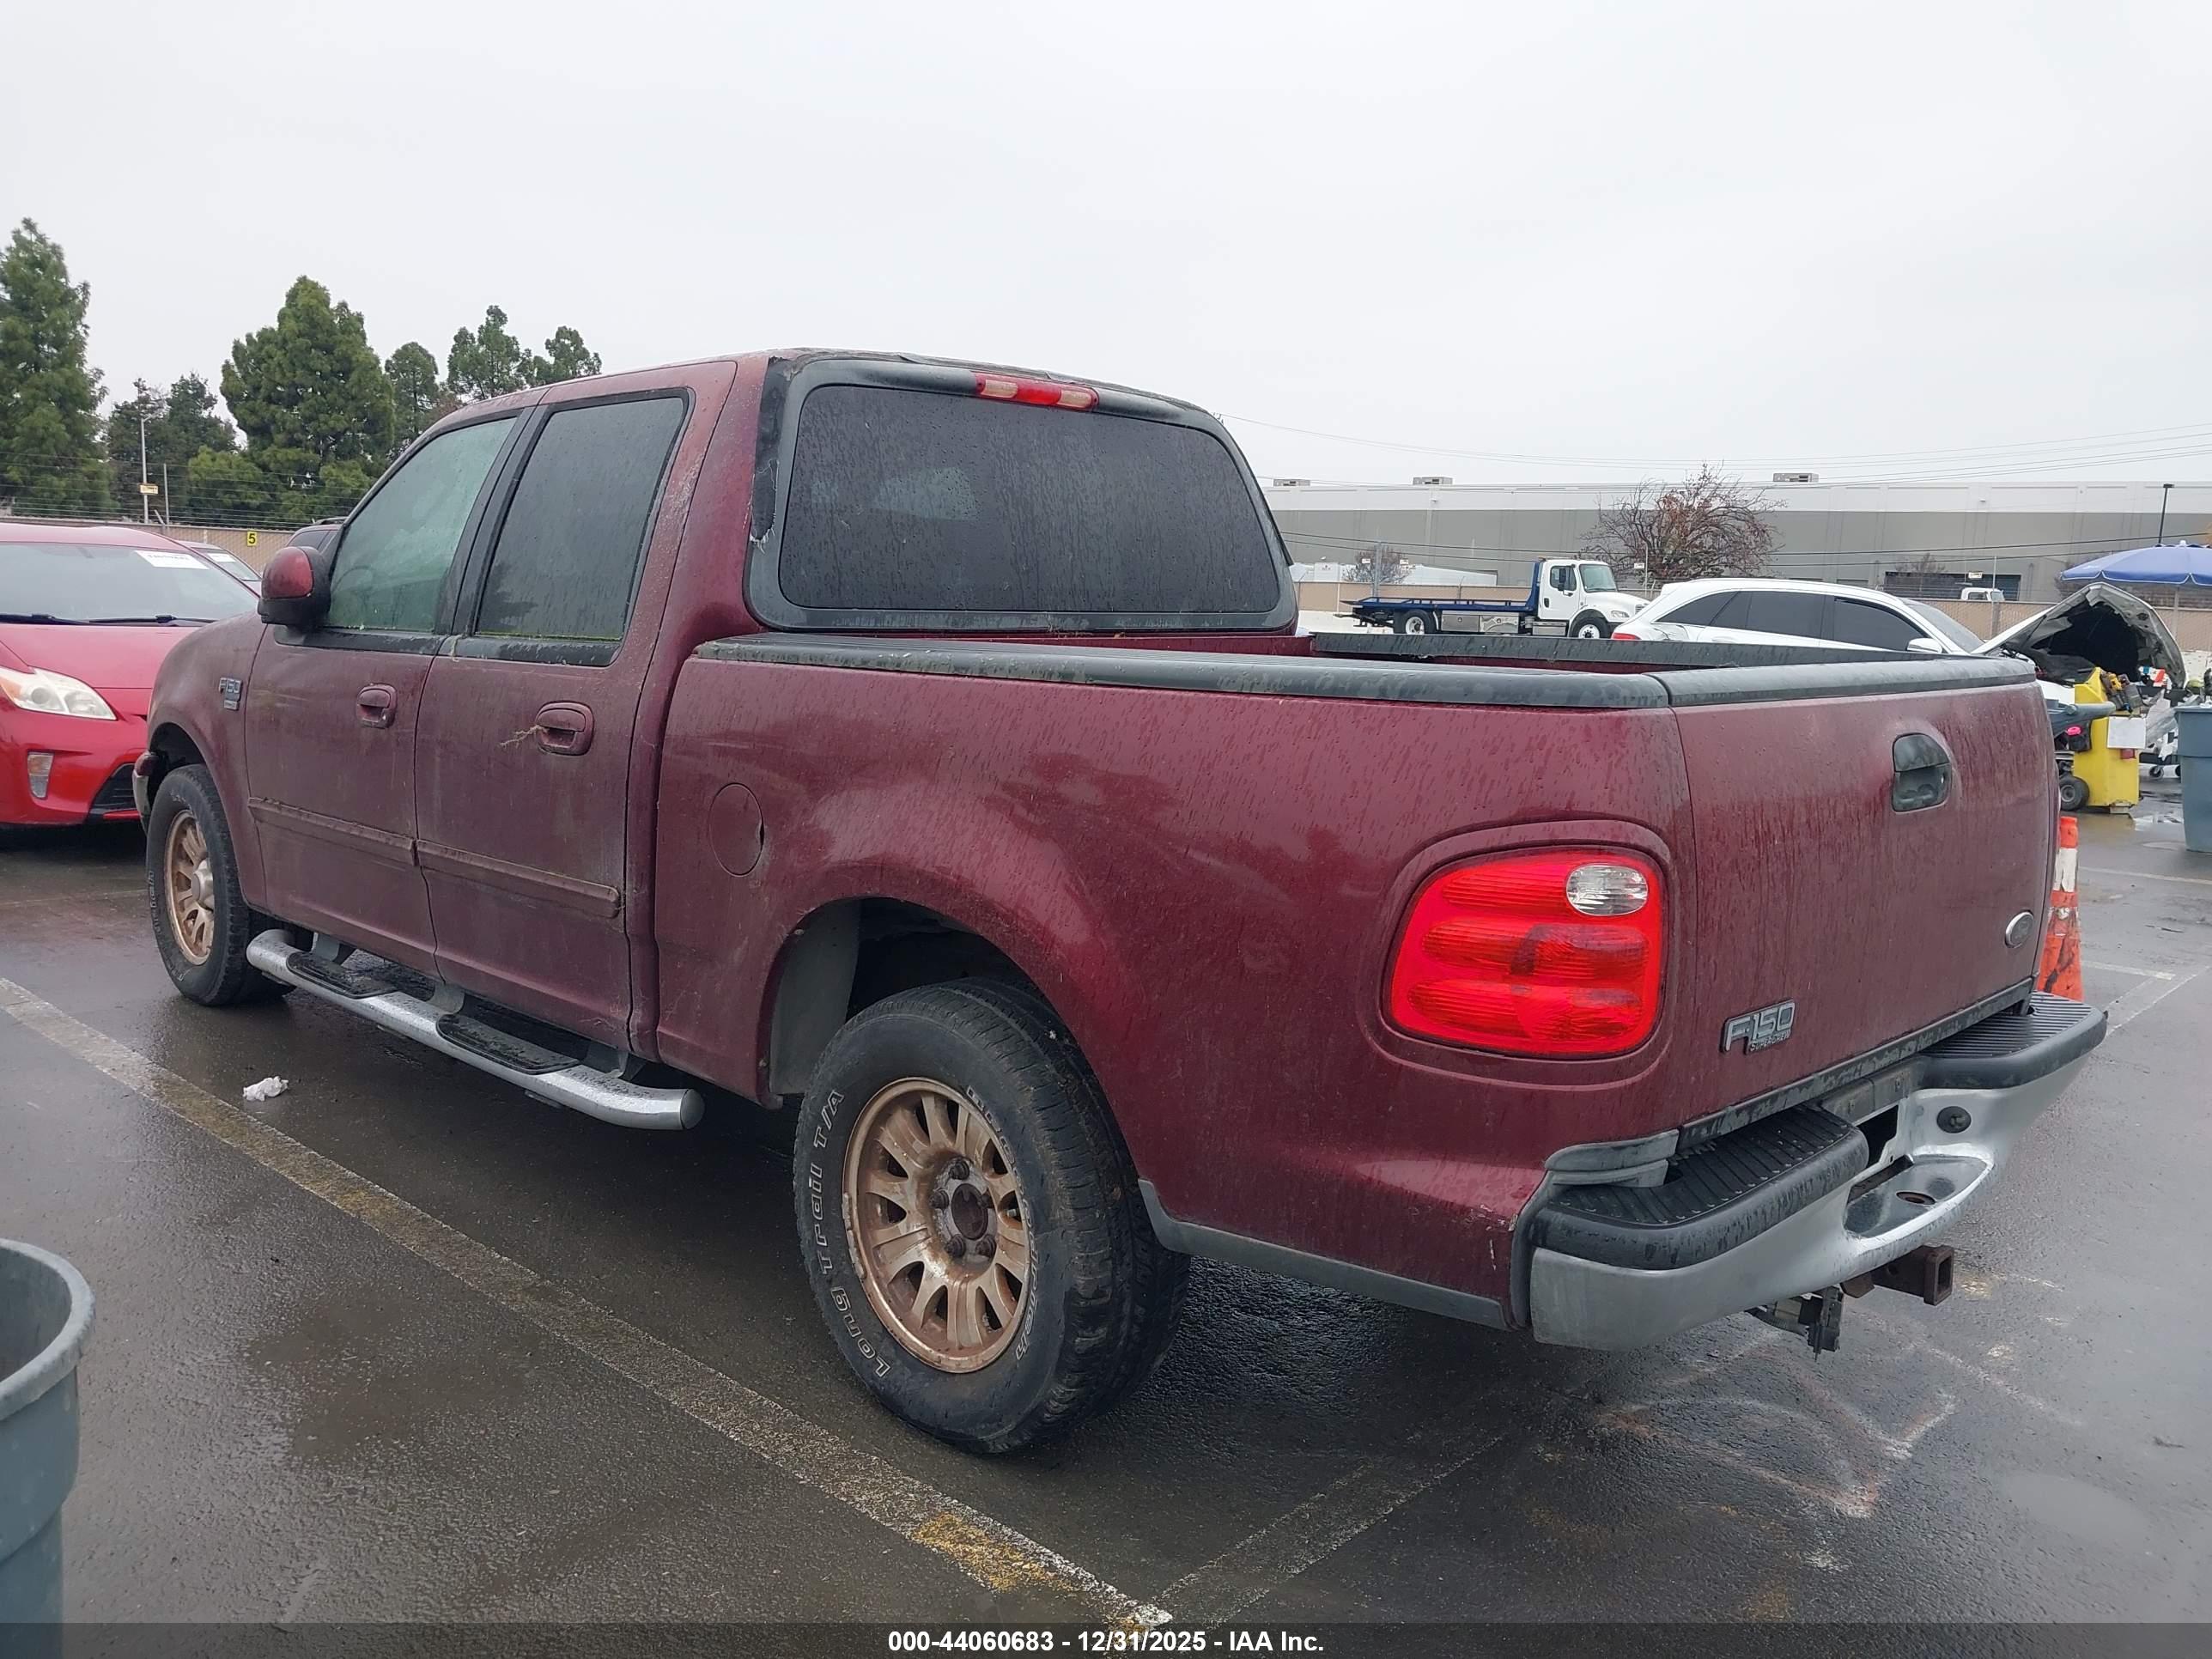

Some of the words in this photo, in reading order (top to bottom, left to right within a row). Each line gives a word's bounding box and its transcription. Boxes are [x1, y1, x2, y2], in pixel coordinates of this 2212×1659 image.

[248, 533, 256, 544] 5
[813, 1089, 845, 1148] T/A
[808, 1162, 834, 1275] Trail
[831, 1286, 891, 1378] Long
